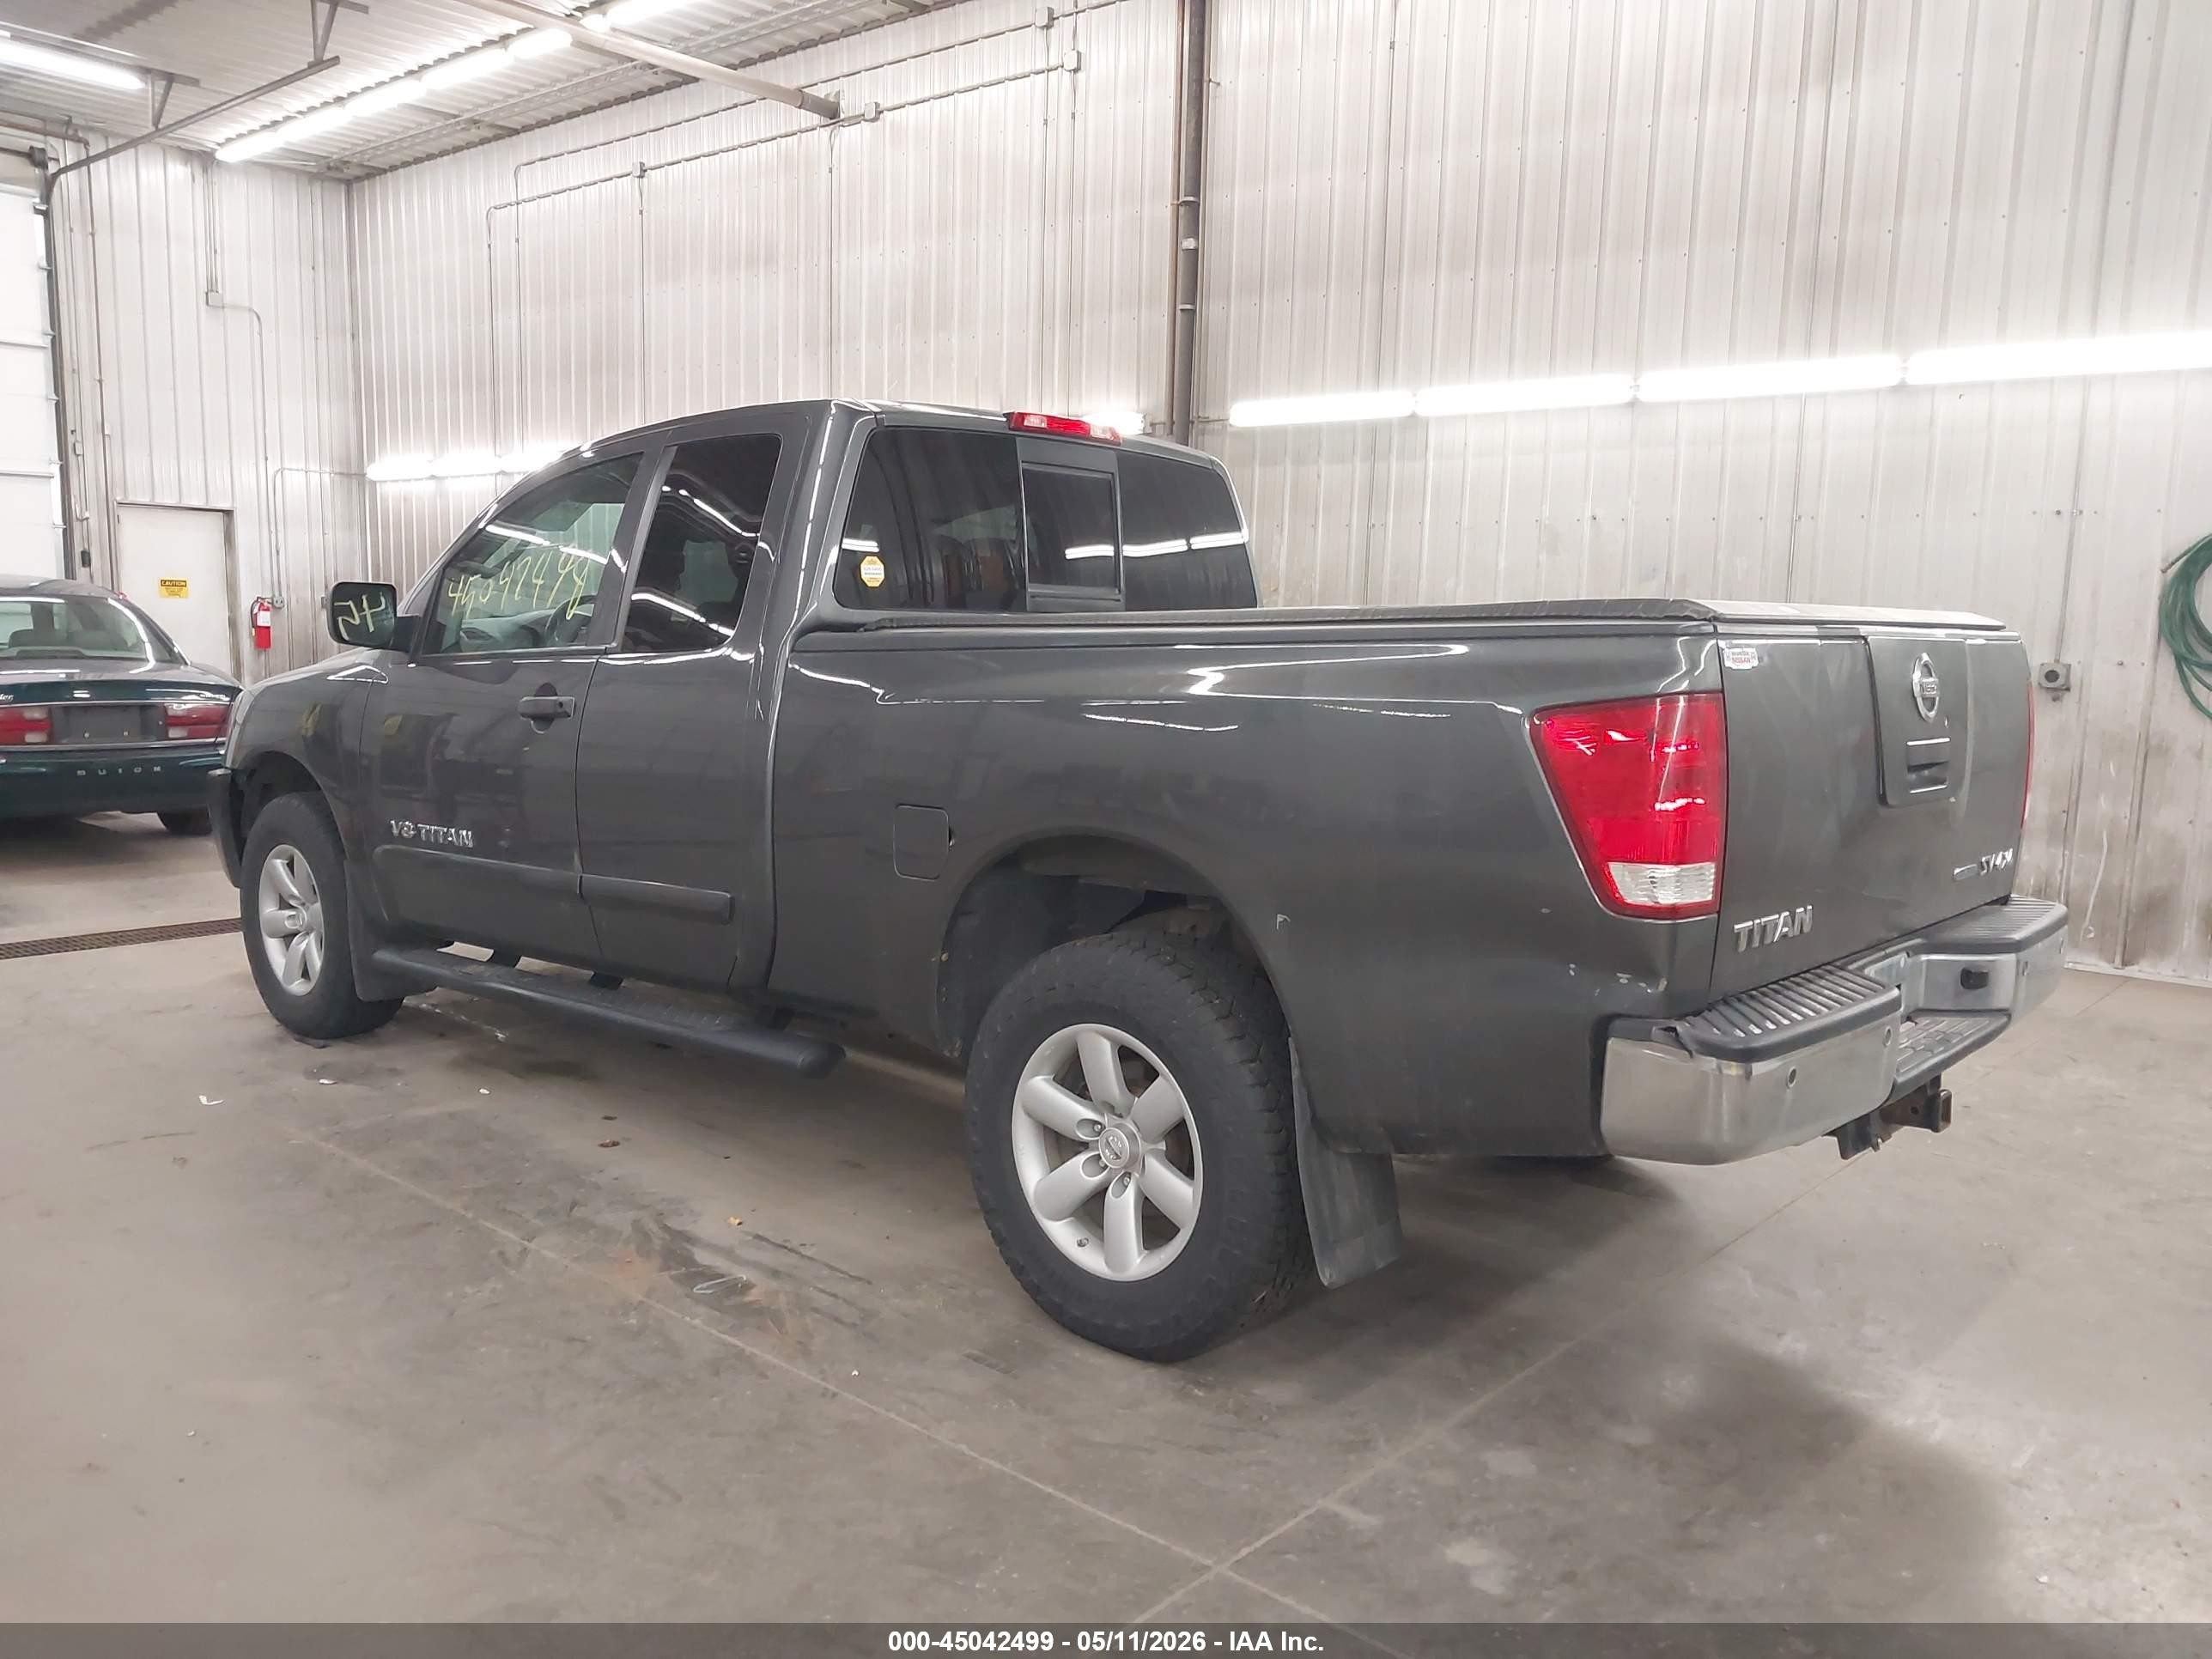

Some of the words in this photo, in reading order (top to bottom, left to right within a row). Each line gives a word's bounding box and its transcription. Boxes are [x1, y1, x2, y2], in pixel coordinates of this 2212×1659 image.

[76, 765, 162, 776] BUICK
[417, 823, 473, 848] TITAN
[1734, 905, 1813, 953] TITAN
